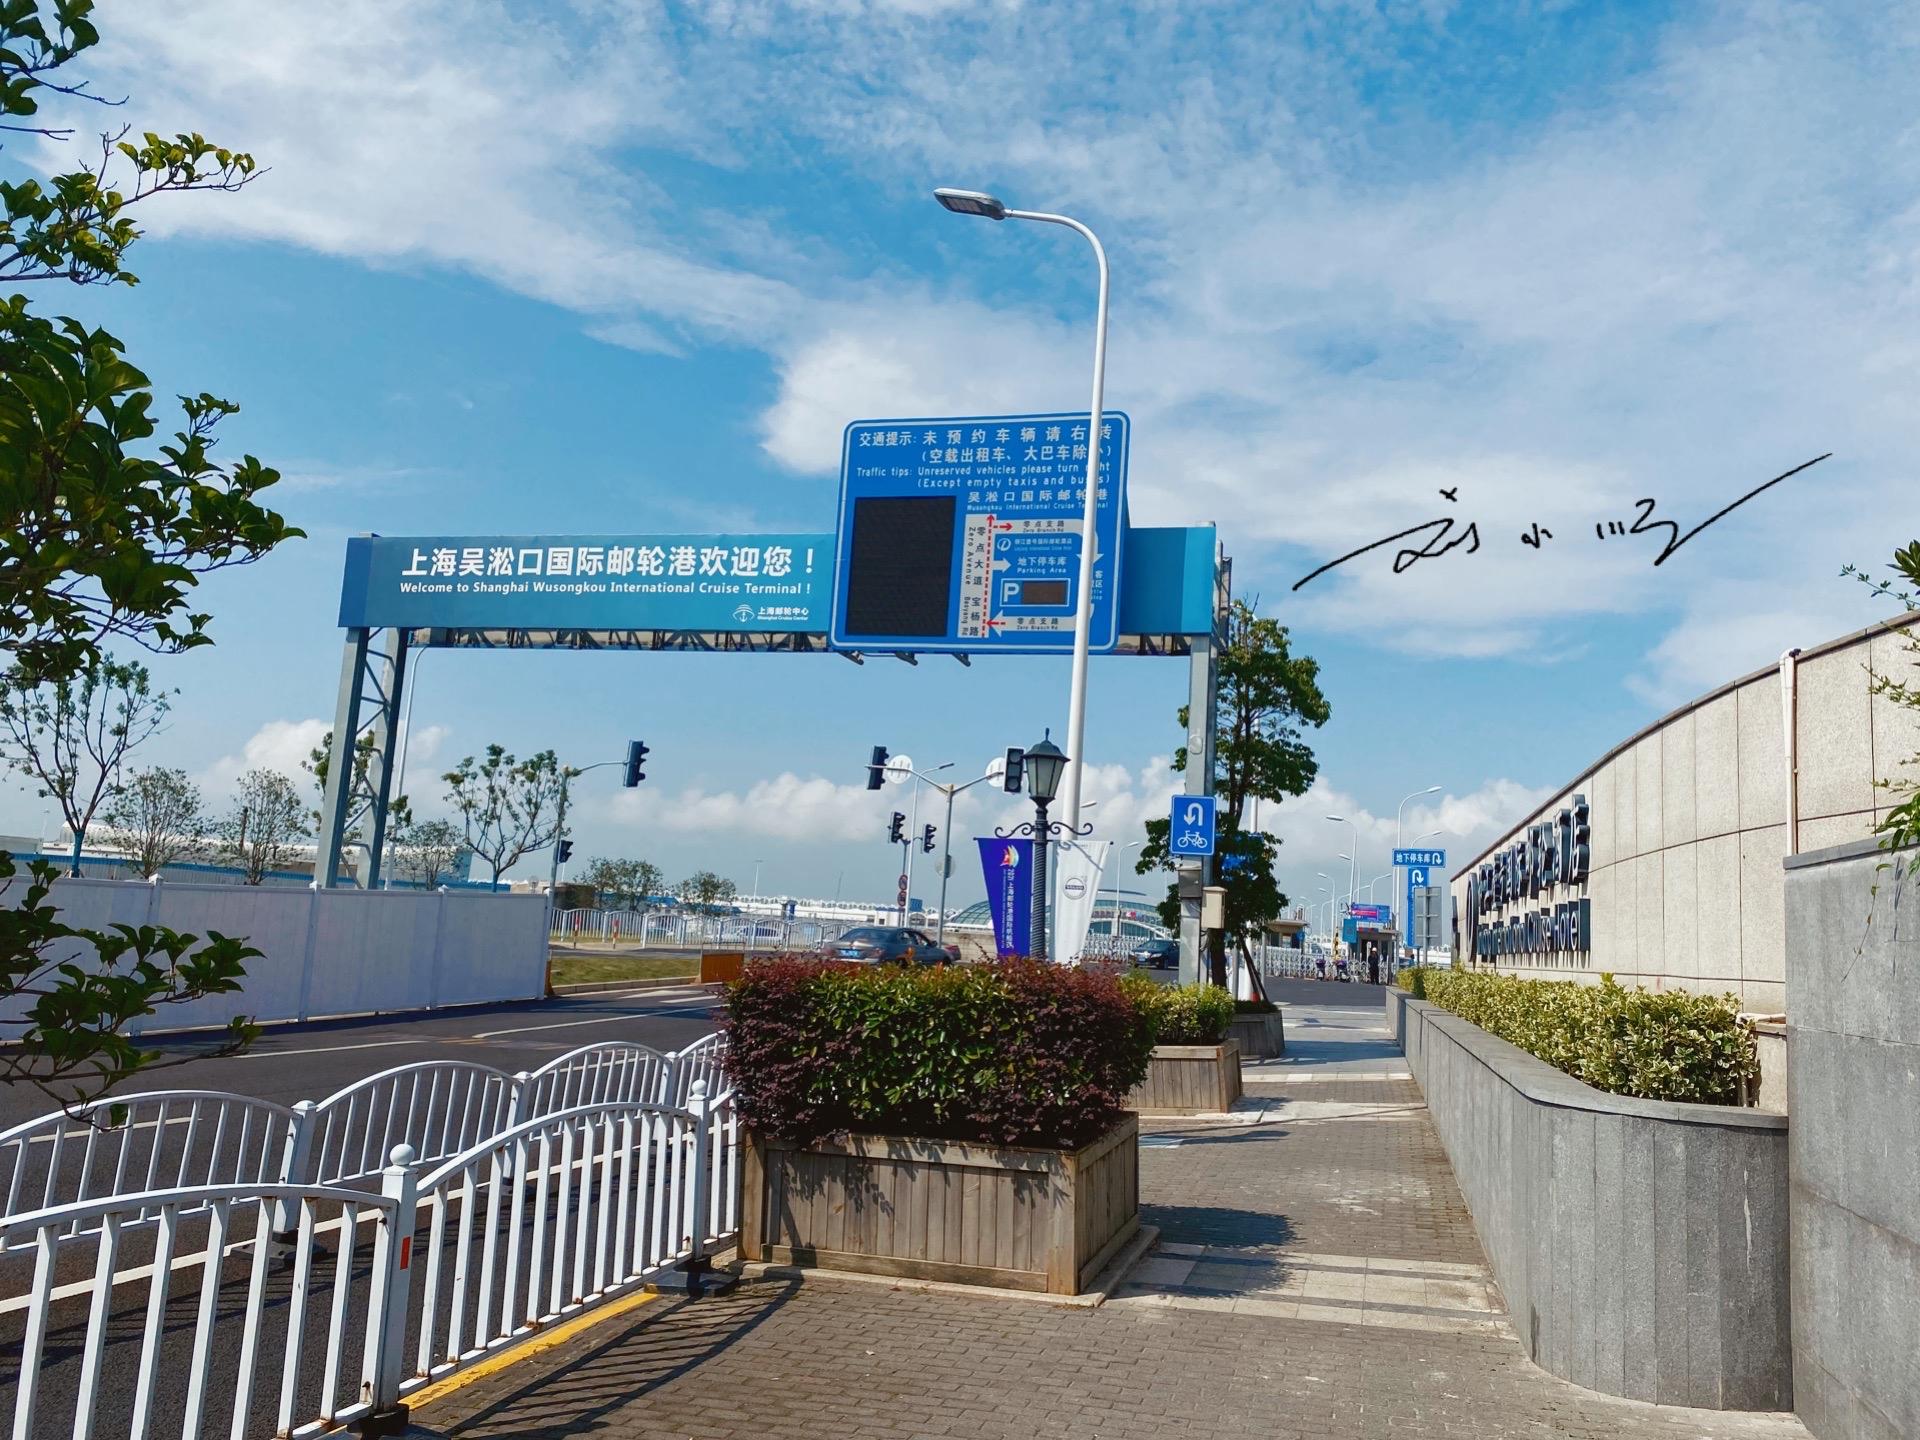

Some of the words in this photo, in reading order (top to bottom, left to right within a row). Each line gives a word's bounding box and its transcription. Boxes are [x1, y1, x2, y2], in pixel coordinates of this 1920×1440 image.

[859, 431, 917, 447] 交通提示:
[857, 467, 886, 477] Traffic
[891, 467, 912, 478] tips:
[918, 466, 971, 476] Unreserved
[976, 464, 1016, 475] vehicles
[1021, 464, 1052, 476] please
[1057, 464, 1079, 473] turn
[918, 478, 961, 489] (Except
[967, 477, 1002, 488] empty
[1008, 477, 1037, 486] taxis
[1043, 476, 1064, 485] and
[1017, 556, 1067, 566] 地下停车库
[400, 582, 452, 593] Welcome
[456, 582, 469, 593] to
[473, 582, 529, 595] Shanghai
[533, 582, 606, 595] Wusongkou
[610, 582, 694, 594] International
[699, 582, 740, 594] Cruise
[1003, 582, 1020, 602] P
